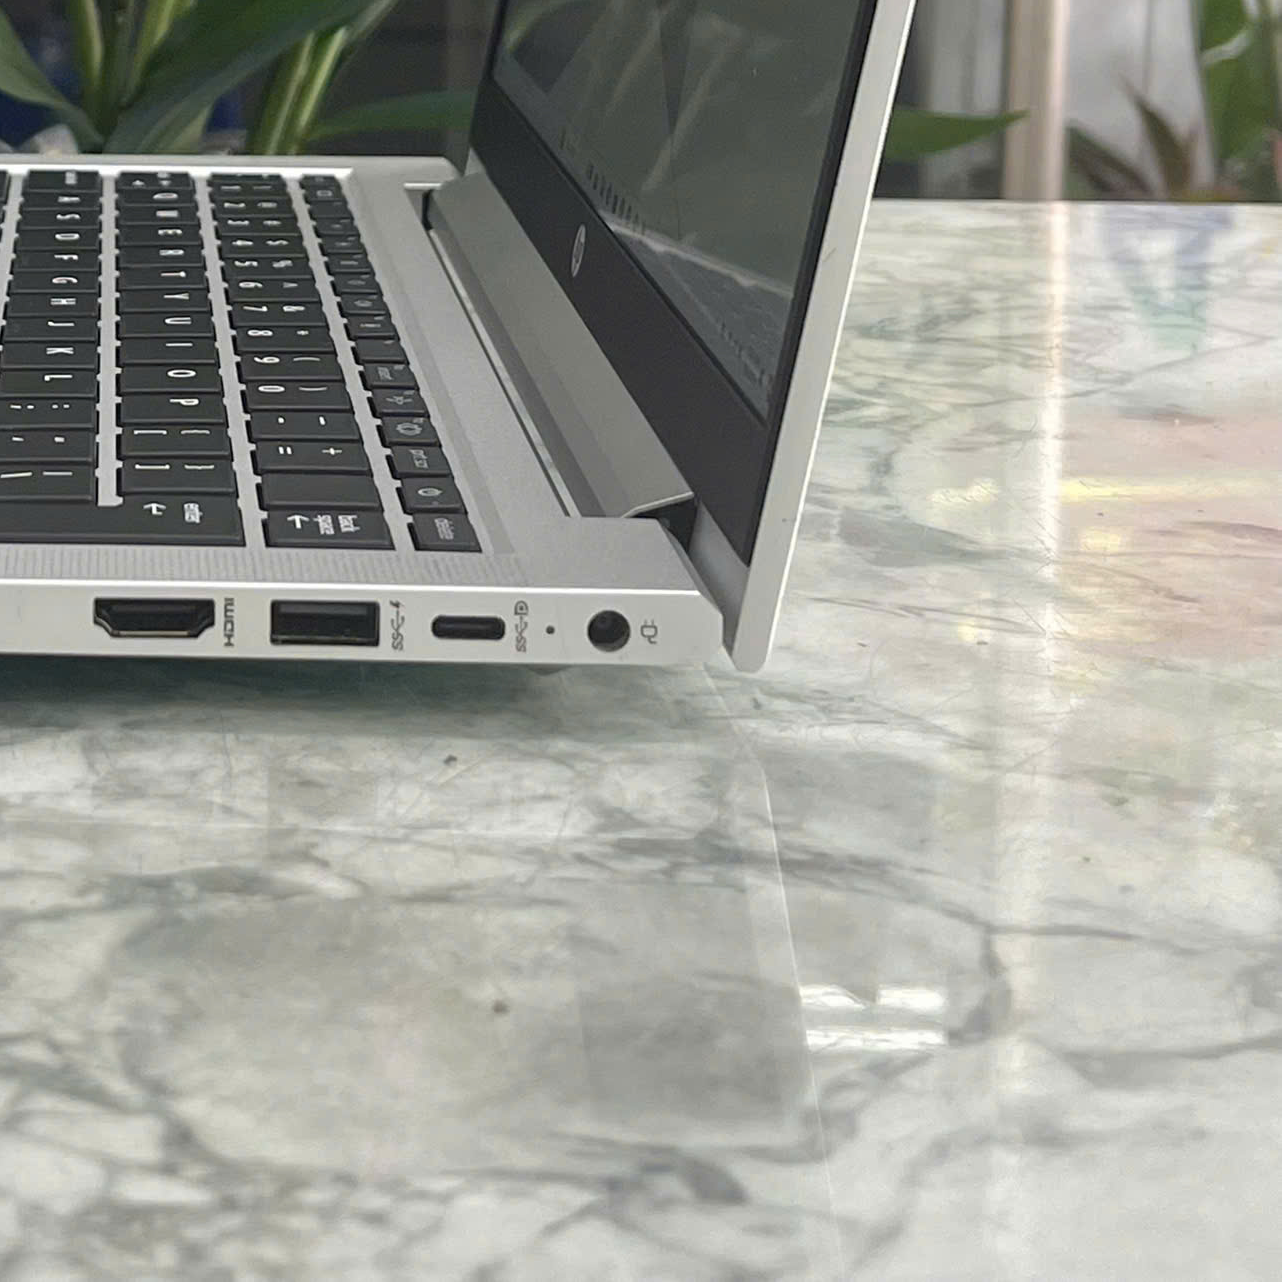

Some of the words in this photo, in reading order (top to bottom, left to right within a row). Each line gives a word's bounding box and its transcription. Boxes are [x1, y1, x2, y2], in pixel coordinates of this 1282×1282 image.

[54, 233, 80, 241] D
[160, 270, 187, 278] T
[51, 276, 78, 284] G
[163, 292, 190, 300] Y
[50, 297, 76, 306] H
[164, 316, 192, 325] U
[247, 329, 274, 337] 8
[46, 347, 74, 355] K
[253, 356, 280, 364] 9
[167, 369, 197, 378] O
[44, 374, 73, 382] L
[257, 385, 286, 393] 0
[169, 398, 200, 406] P
[223, 597, 235, 648] HDMI
